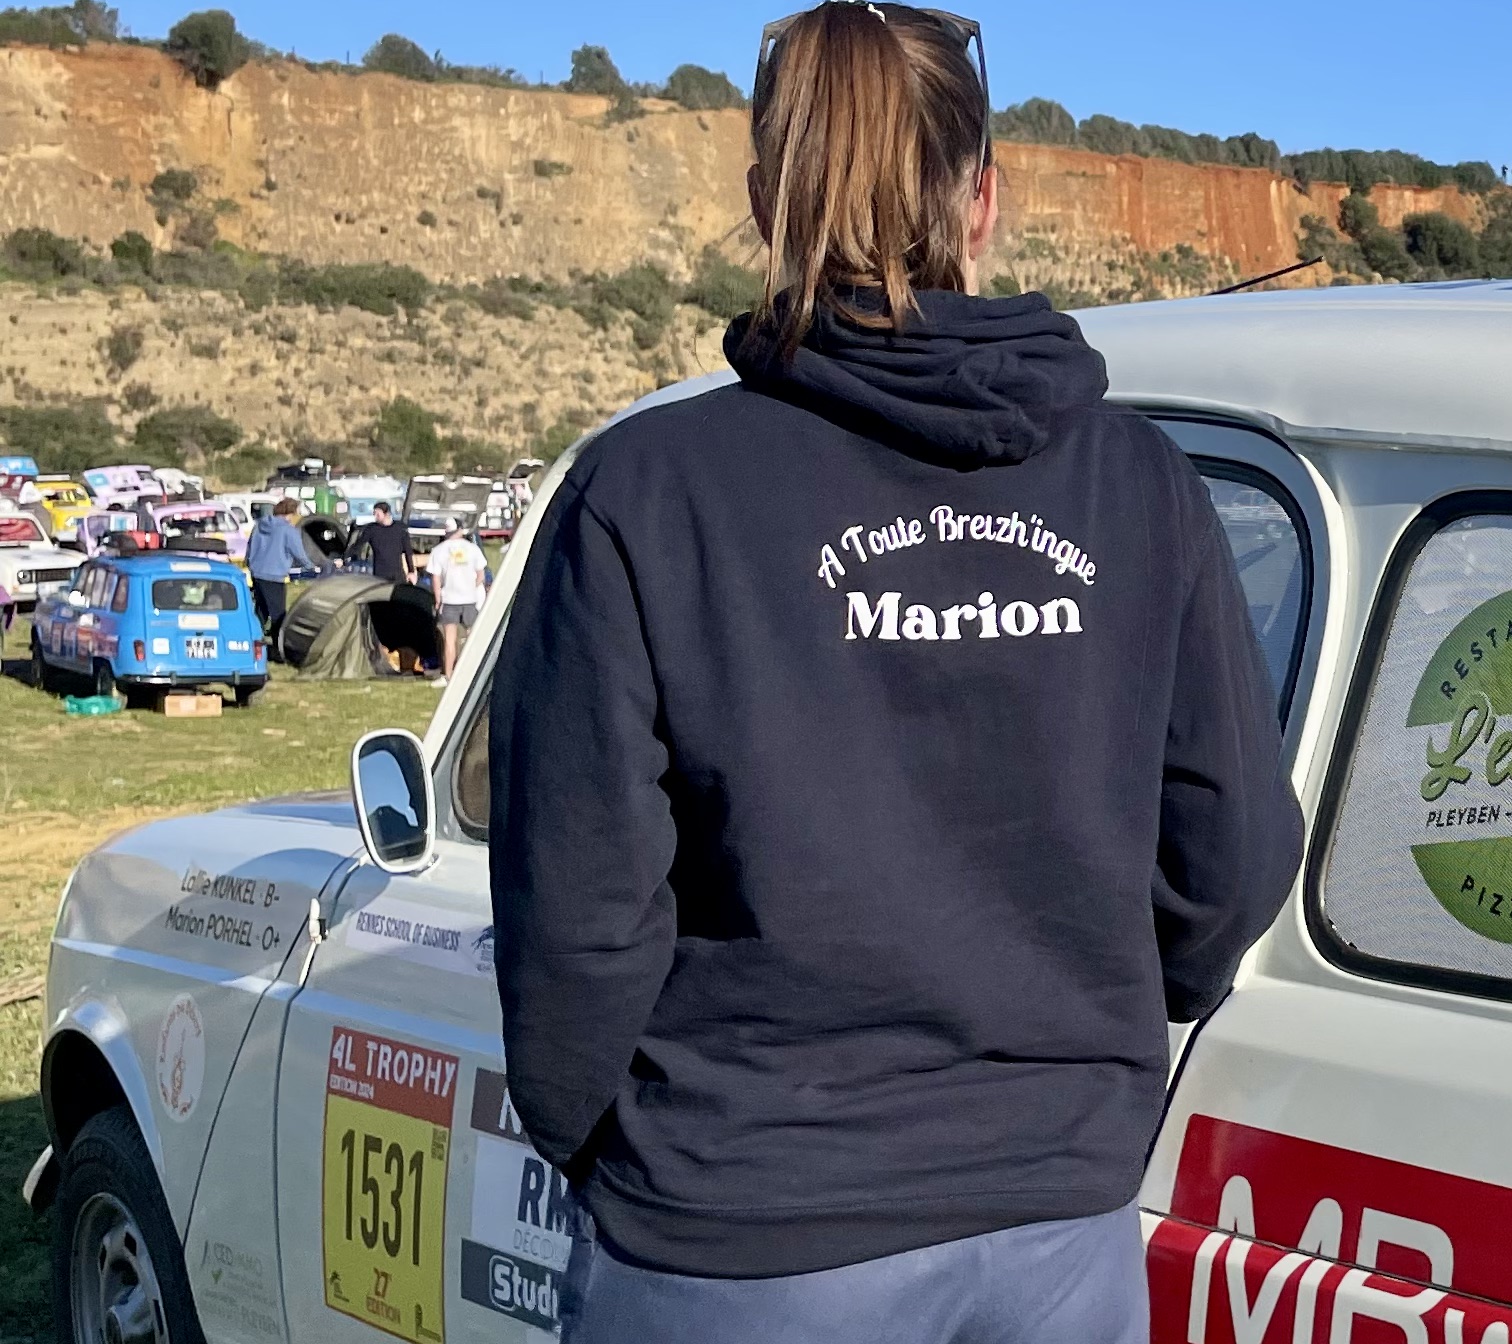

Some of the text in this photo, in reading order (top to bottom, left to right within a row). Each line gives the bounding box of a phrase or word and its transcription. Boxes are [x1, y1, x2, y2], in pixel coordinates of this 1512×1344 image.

[818, 542, 846, 589] A
[841, 516, 926, 563] Toute
[845, 590, 1084, 641] Marion
[1426, 804, 1501, 829] PLEYBEN
[165, 905, 205, 935] Marion
[205, 913, 253, 947] PORHEL
[356, 911, 461, 952] RENNES SCHOOL OF BUSINESS
[332, 1033, 456, 1098] 4L TROPHY
[340, 1128, 425, 1267] 1531
